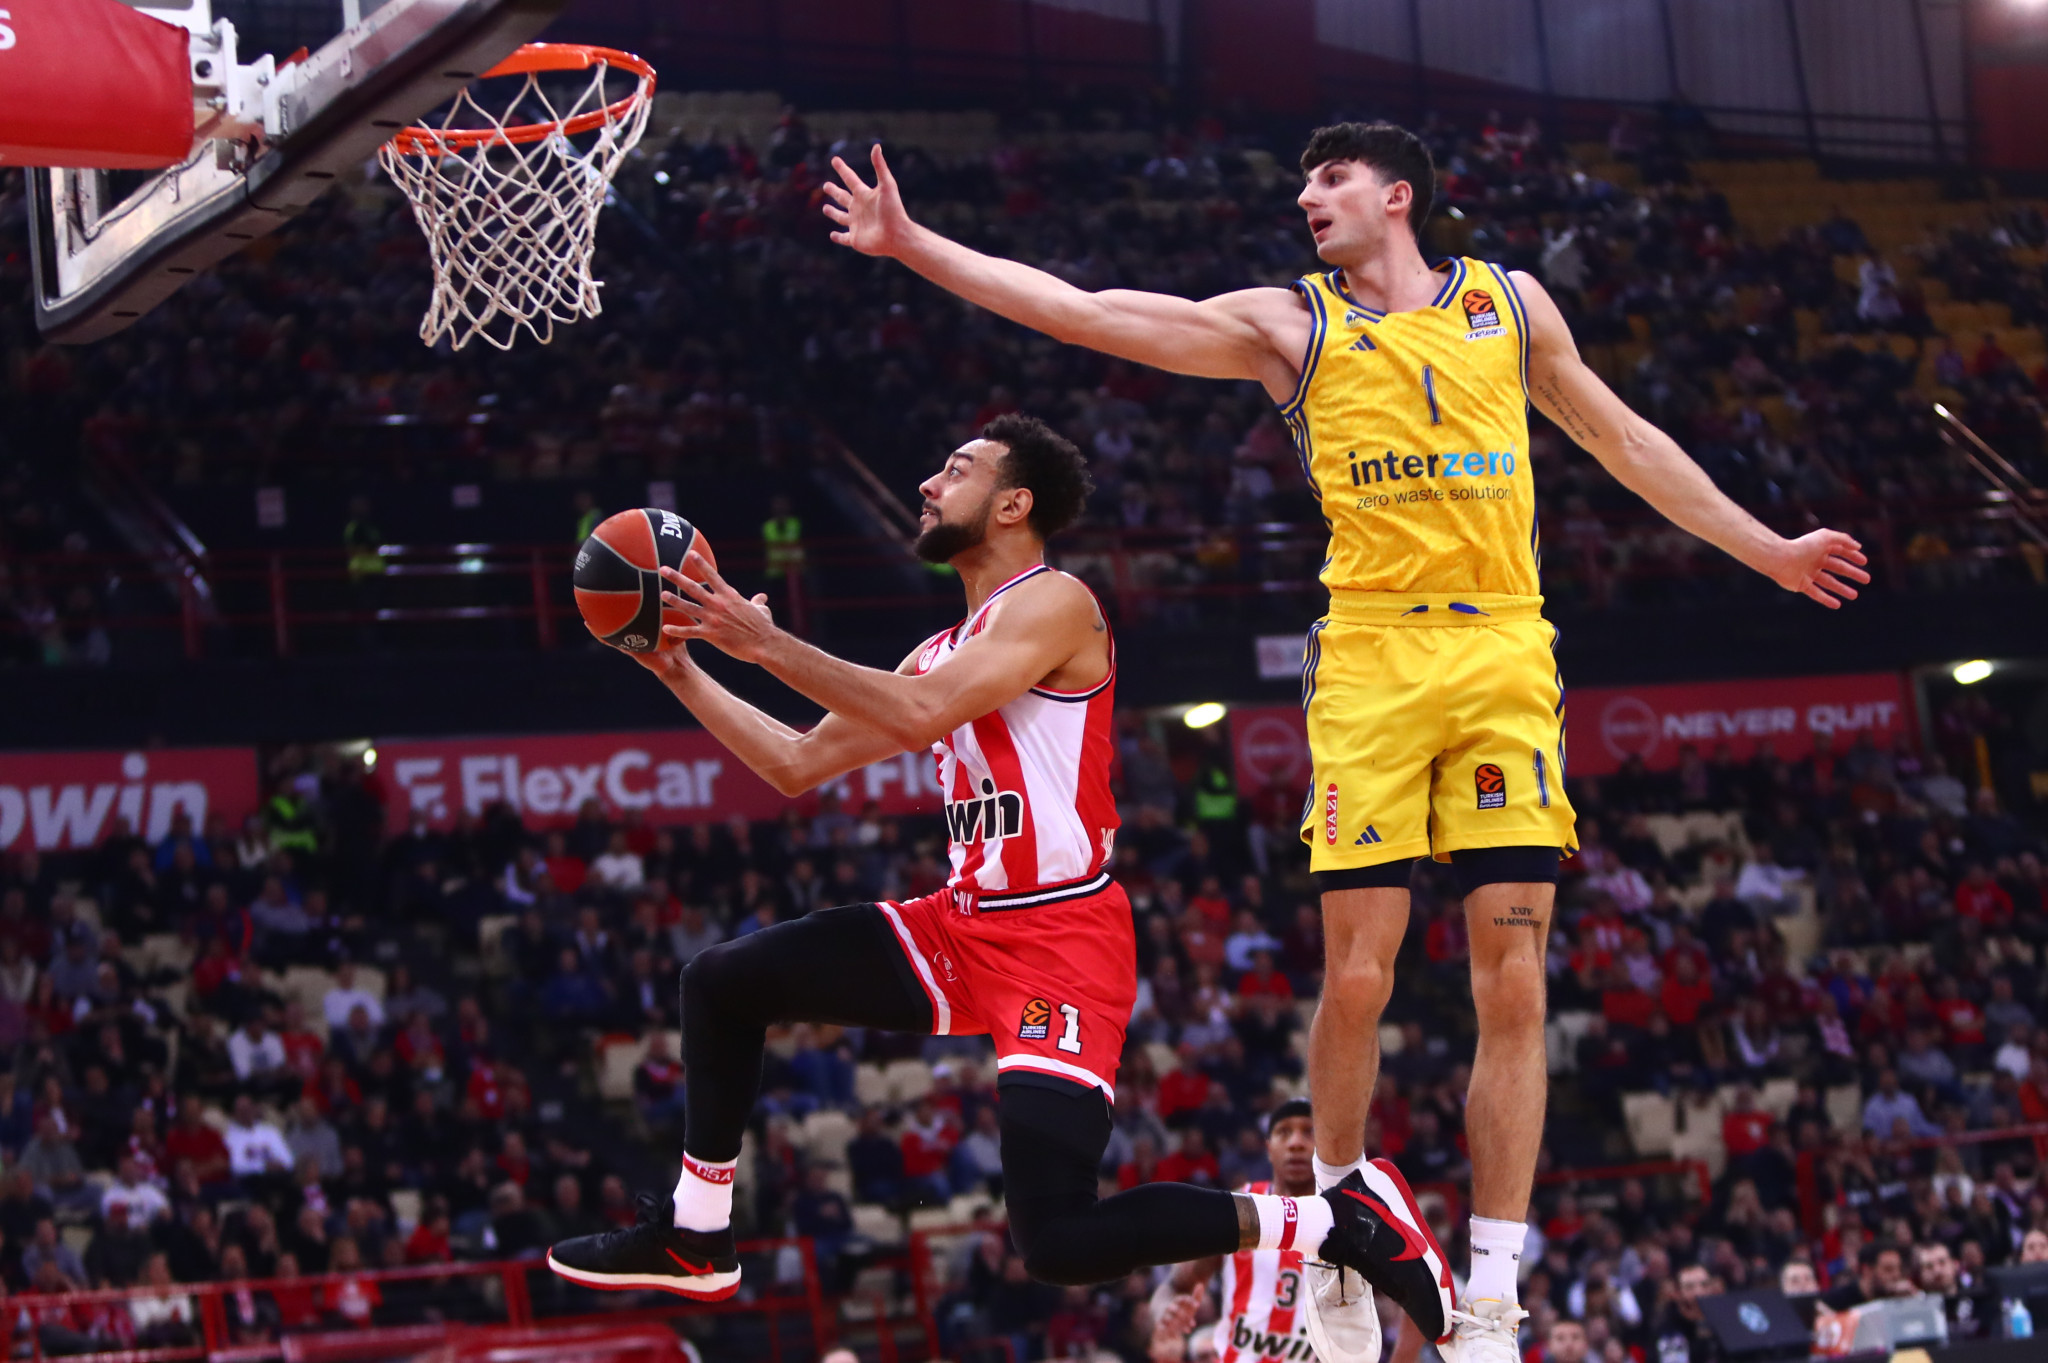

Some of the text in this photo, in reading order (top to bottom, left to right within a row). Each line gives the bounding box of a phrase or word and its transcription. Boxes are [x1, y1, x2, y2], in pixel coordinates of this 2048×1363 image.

[1421, 365, 1442, 425] 1
[1348, 451, 1516, 487] interzero
[1356, 494, 1389, 510] zero
[1394, 487, 1444, 504] waste
[1663, 707, 1796, 739] NEVER
[1807, 702, 1897, 734] QUIT
[460, 750, 721, 815] FlexCar
[1533, 748, 1550, 808] 1
[1327, 790, 1337, 839] GAZI
[1058, 1003, 1081, 1054] 1
[1277, 1271, 1299, 1307] 3
